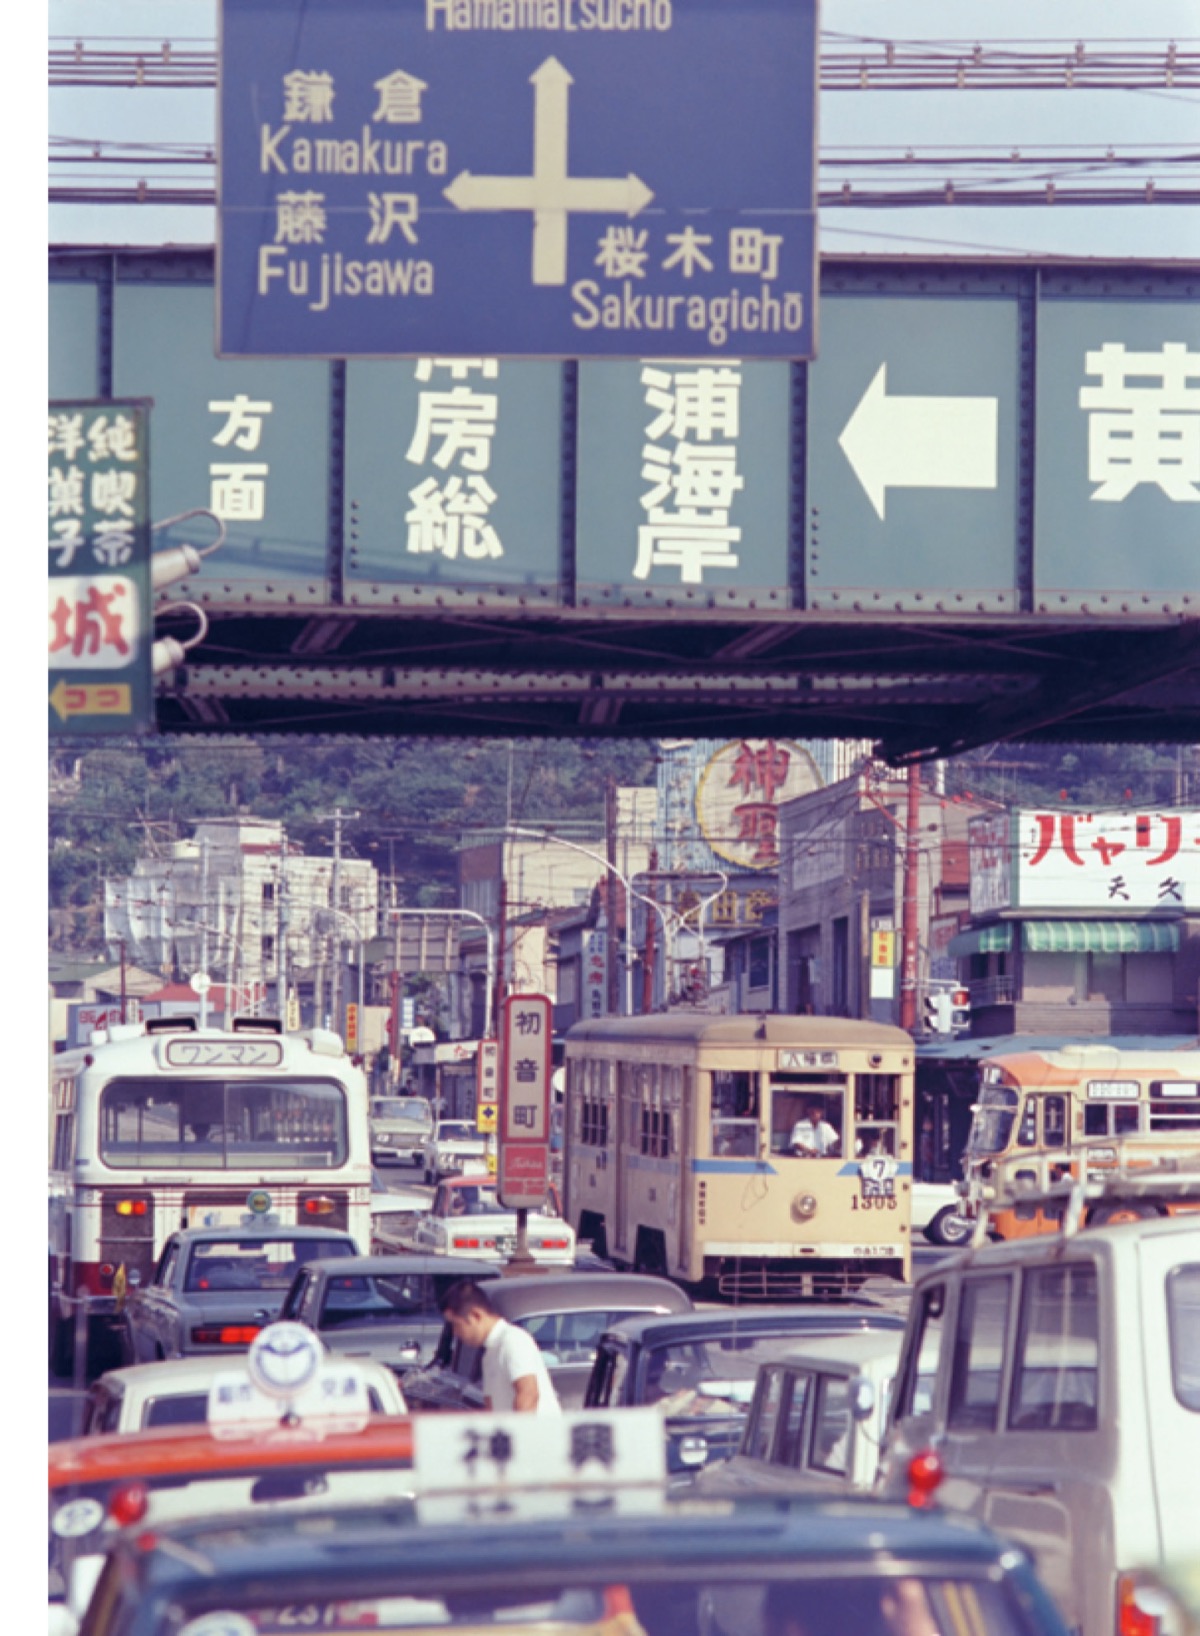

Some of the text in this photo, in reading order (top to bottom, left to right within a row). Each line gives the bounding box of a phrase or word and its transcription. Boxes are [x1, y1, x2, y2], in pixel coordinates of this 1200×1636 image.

[283, 69, 428, 123] 鎌倉
[260, 124, 448, 175] Kamakura
[274, 190, 418, 244] 藤沢
[258, 246, 433, 311] Fujisawa
[595, 226, 783, 280] 桜木町
[1079, 342, 1200, 502] 黄
[208, 394, 272, 521] 方面
[632, 358, 744, 583] 浦海岸
[87, 413, 138, 567] 純喫茶
[181, 1044, 268, 1065] ワンマン
[512, 1010, 543, 1130] 初音町
[872, 1158, 886, 1178] 7
